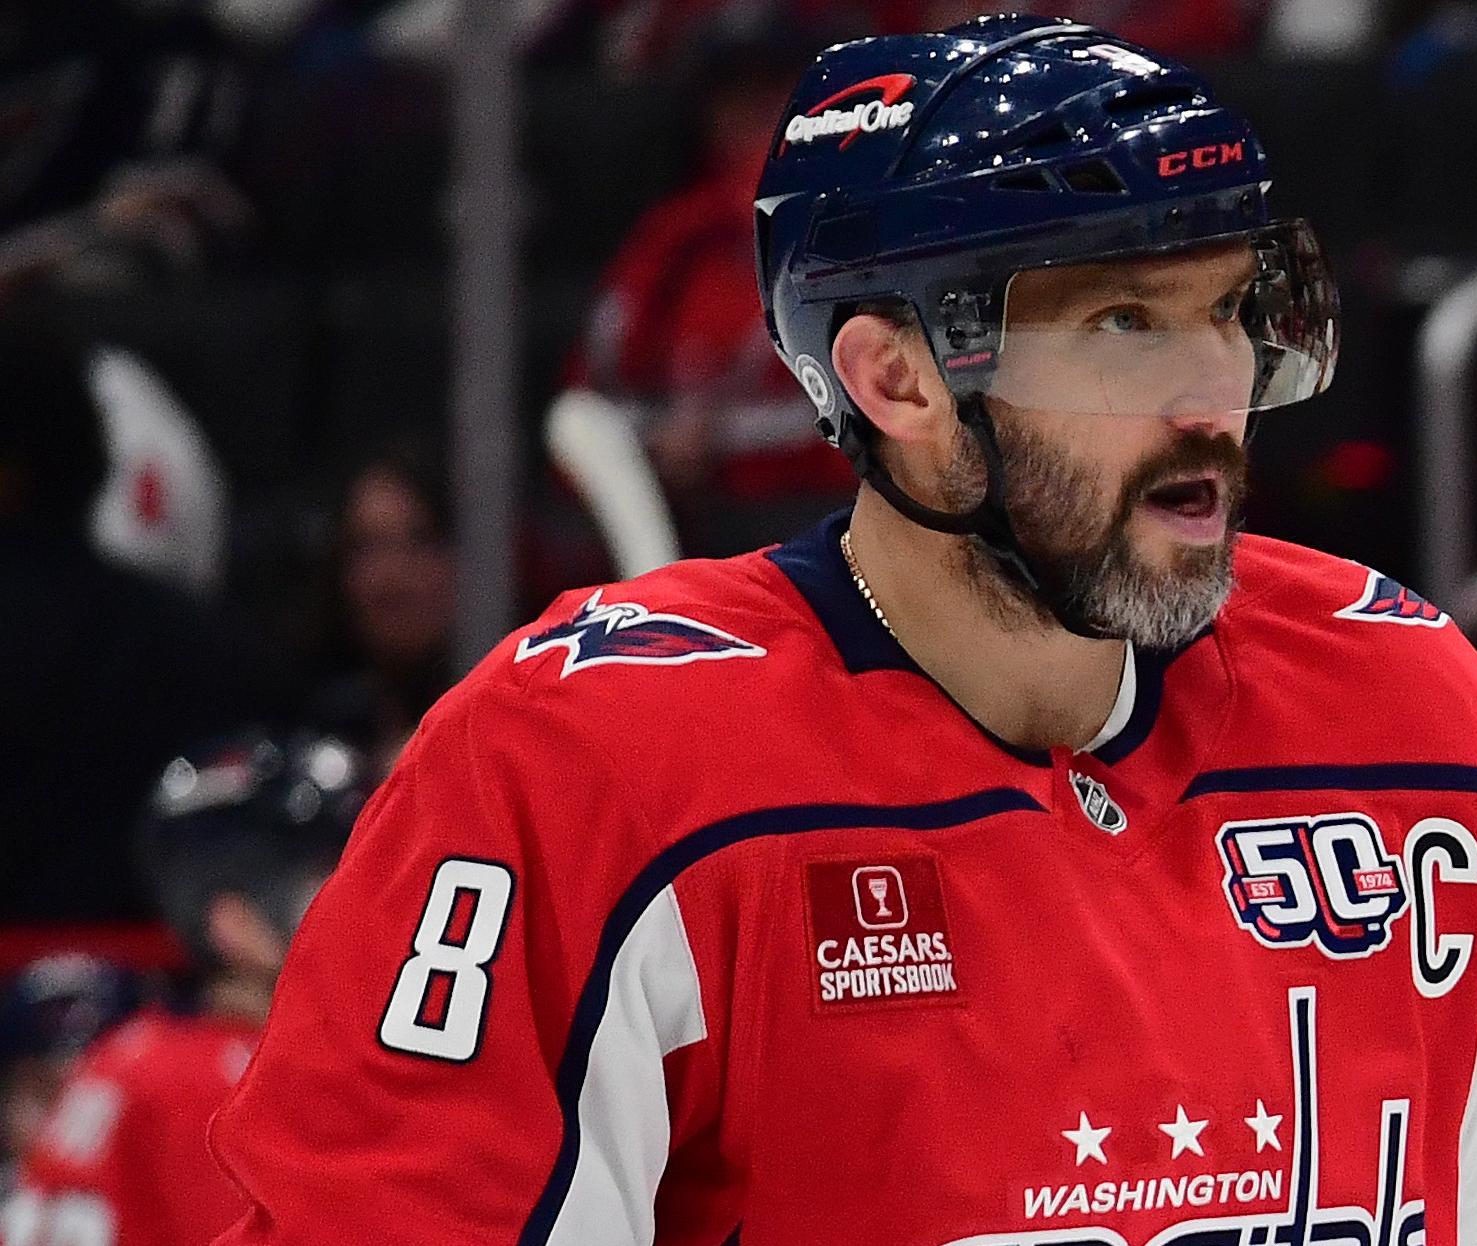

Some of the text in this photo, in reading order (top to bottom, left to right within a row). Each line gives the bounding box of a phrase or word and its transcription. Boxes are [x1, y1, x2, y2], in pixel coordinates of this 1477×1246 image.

[1157, 141, 1243, 177] CCM
[1231, 819, 1394, 927] 50
[1249, 871, 1394, 898] EST 1974
[380, 857, 517, 1063] 8
[819, 963, 957, 1001] SPORTSBOOK
[1023, 1169, 1283, 1219] WASHINGTON
